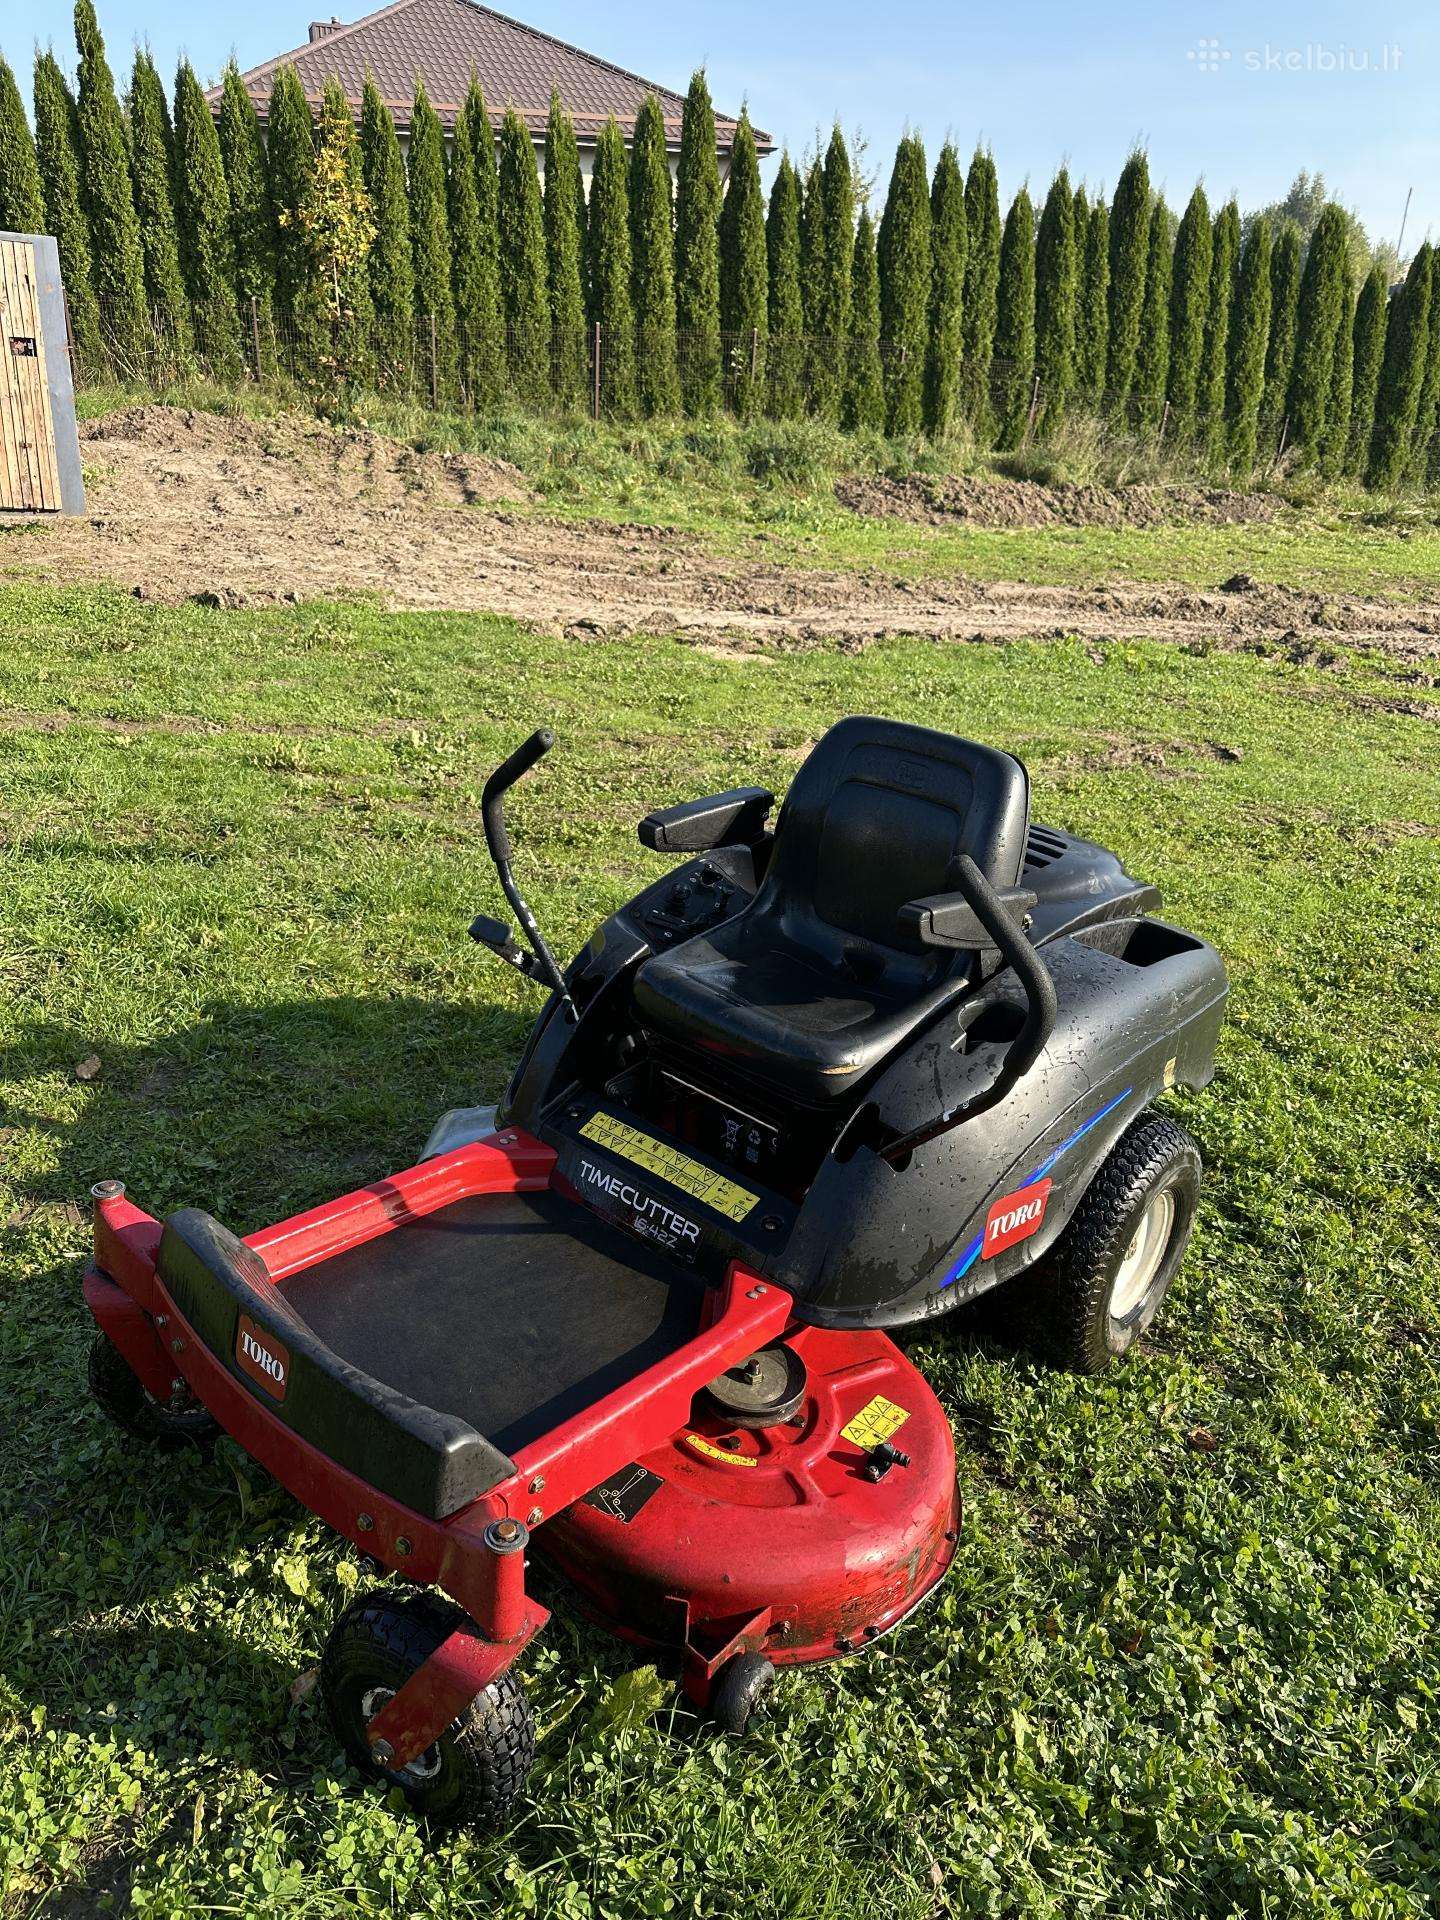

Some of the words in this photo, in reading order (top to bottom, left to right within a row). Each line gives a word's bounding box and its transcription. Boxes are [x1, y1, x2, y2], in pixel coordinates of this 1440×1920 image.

[580, 1160, 700, 1243] TIMECUTTER
[989, 1198, 1042, 1241] TORO
[243, 1332, 285, 1383] TORO
